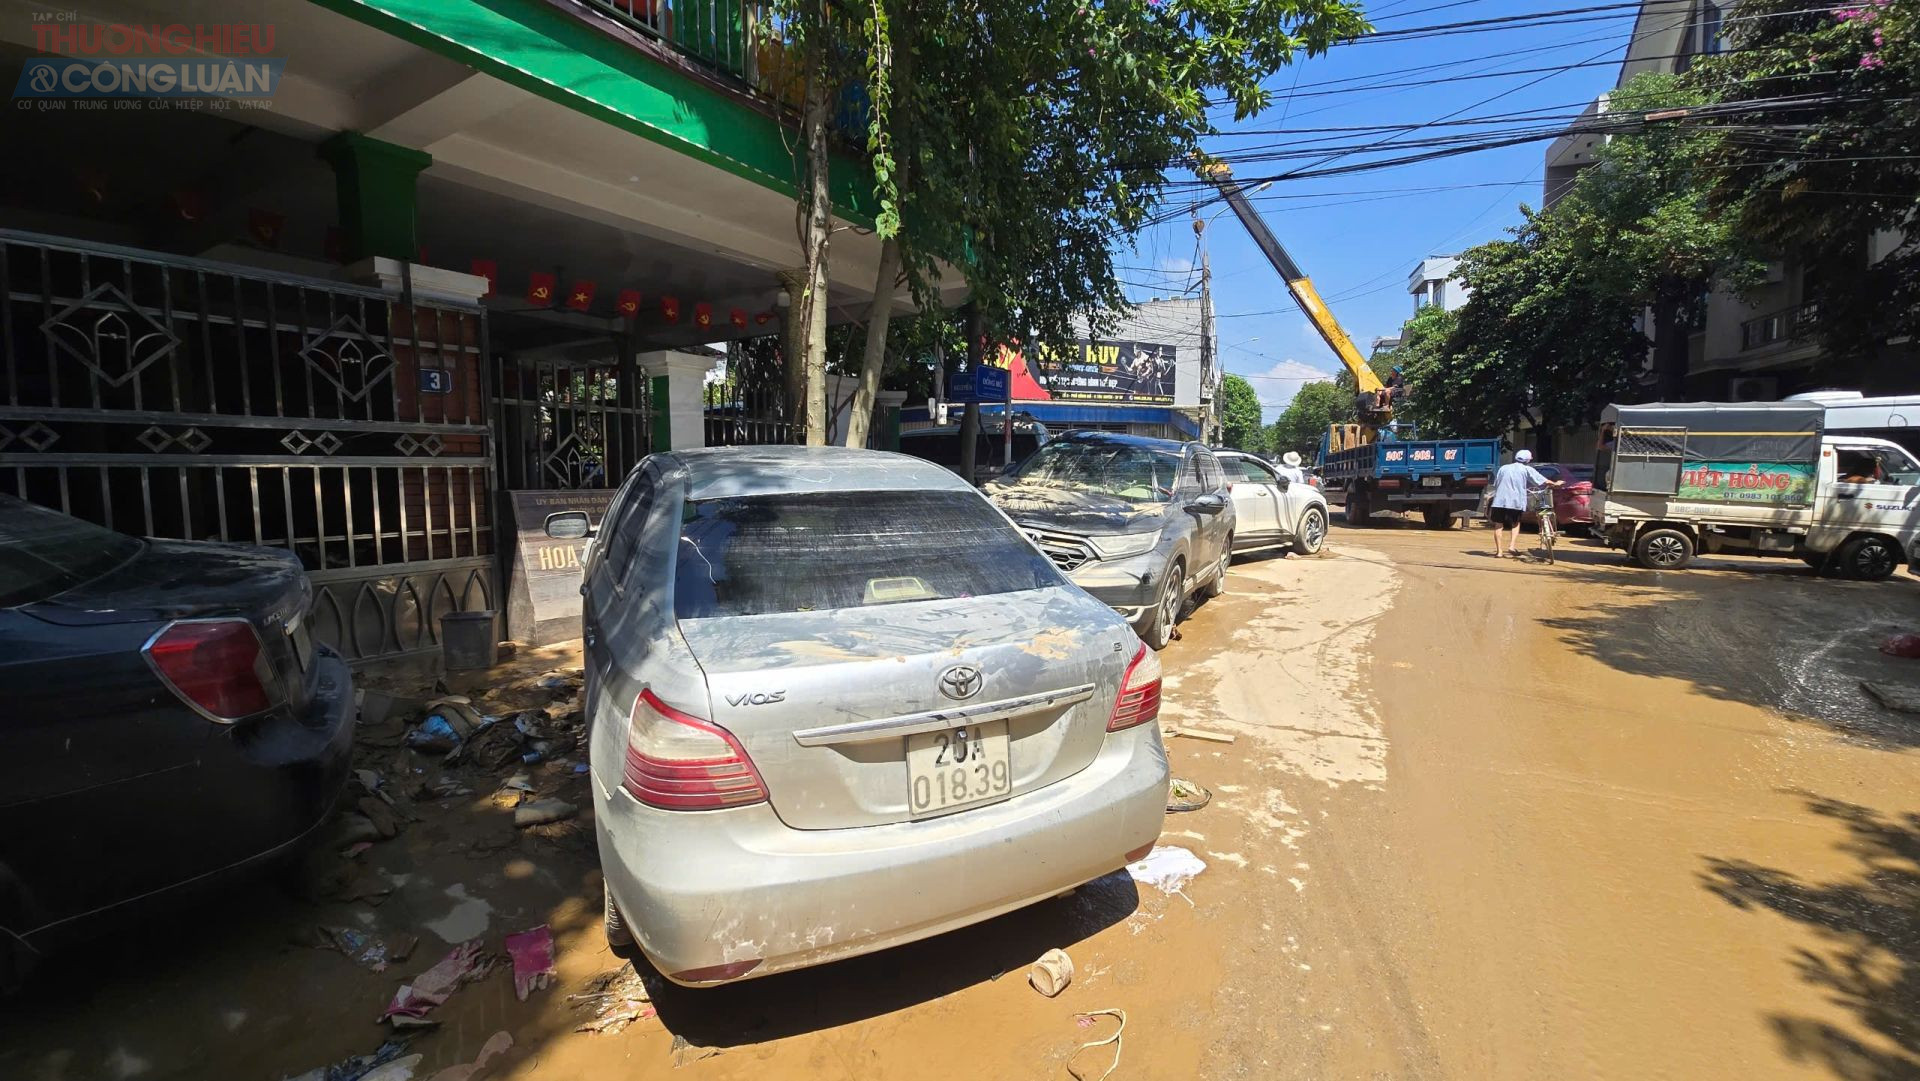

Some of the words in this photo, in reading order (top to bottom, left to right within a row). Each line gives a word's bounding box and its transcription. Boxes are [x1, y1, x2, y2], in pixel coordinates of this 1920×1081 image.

[430, 372, 441, 390] 3
[1728, 463, 1791, 490] HỒNG
[539, 544, 580, 571] HOA
[725, 690, 786, 707] VIOS
[933, 727, 986, 768] 20A
[913, 759, 1007, 809] 018.39
